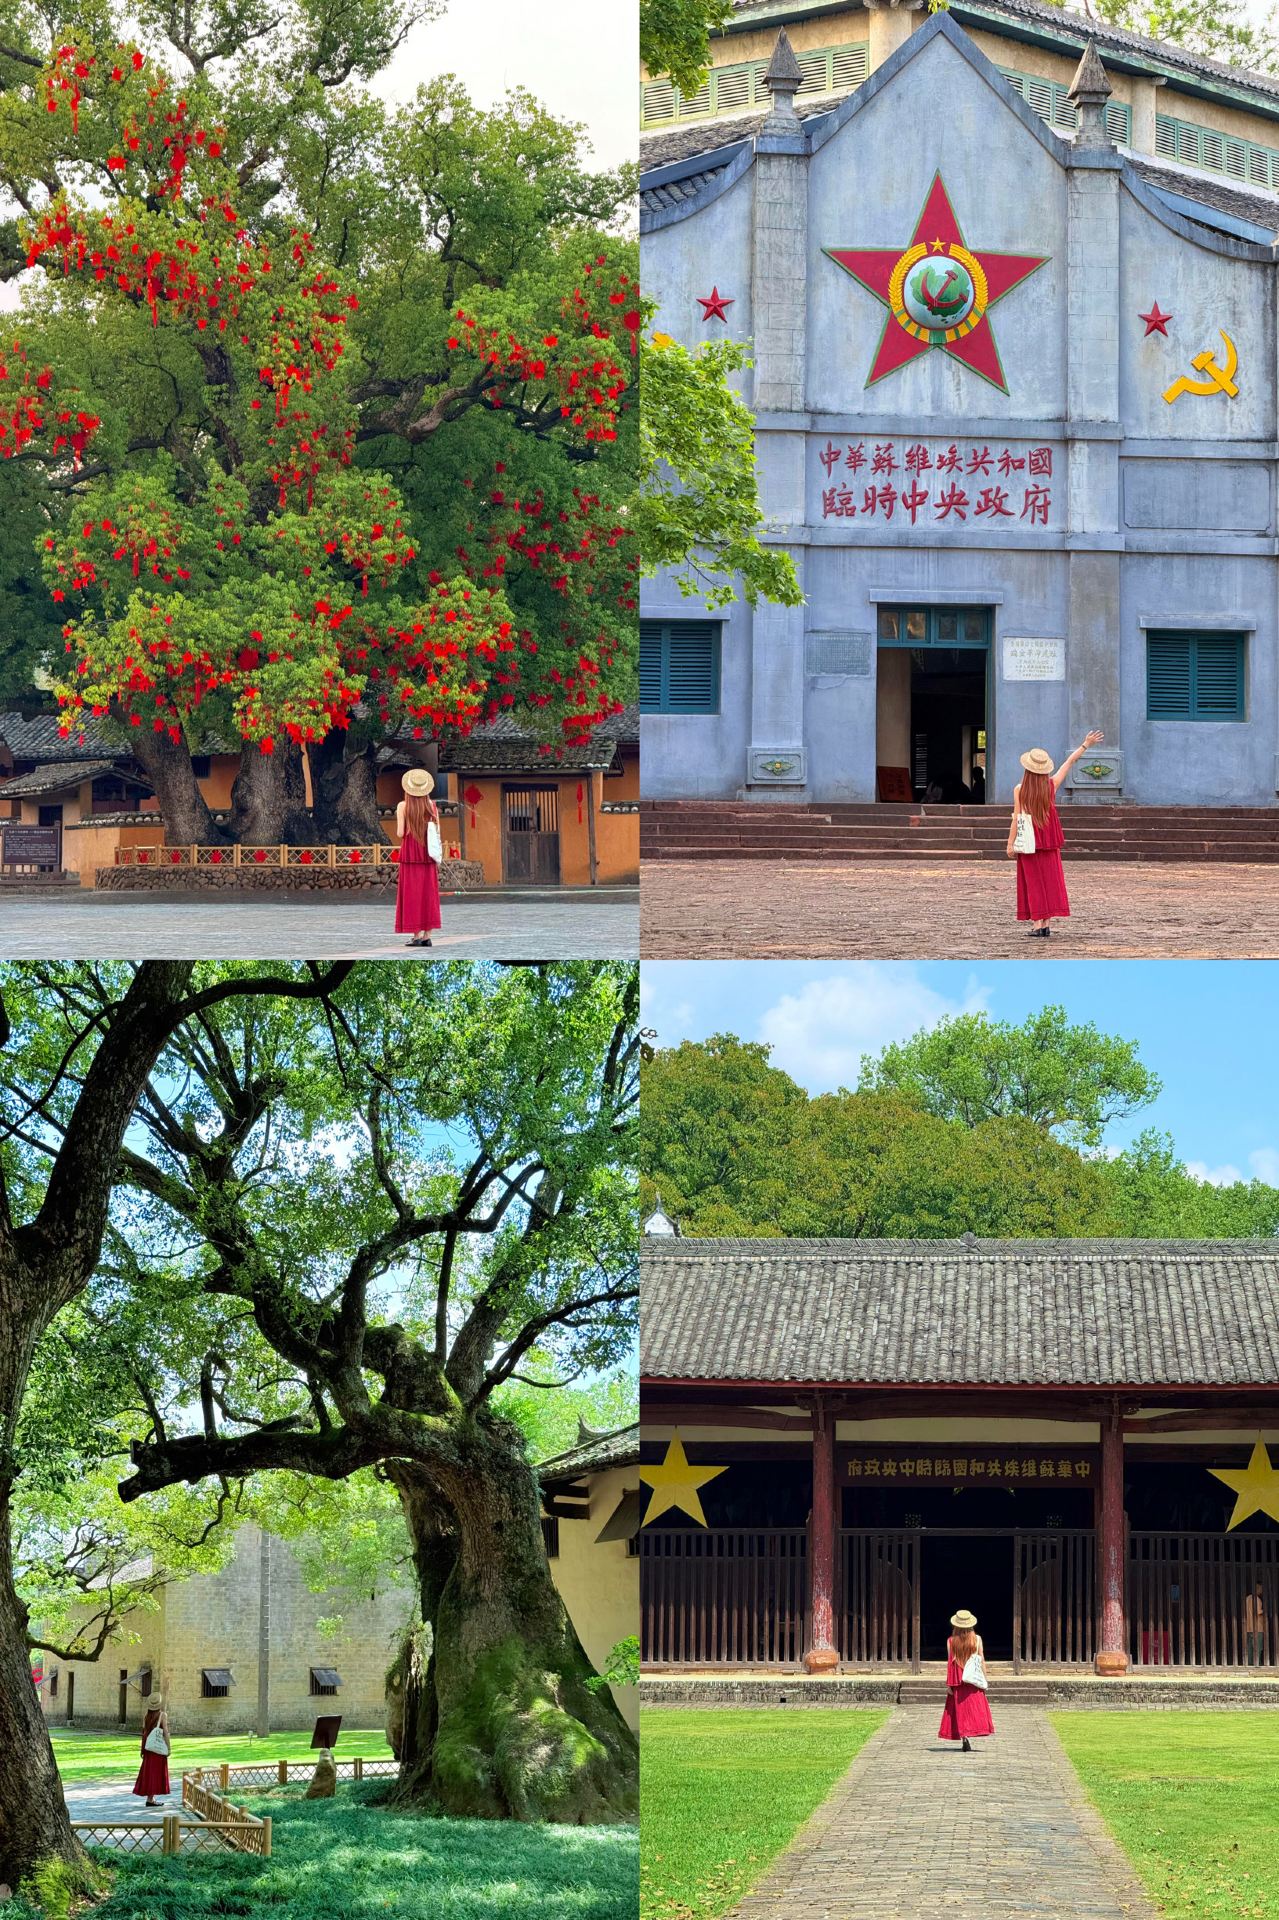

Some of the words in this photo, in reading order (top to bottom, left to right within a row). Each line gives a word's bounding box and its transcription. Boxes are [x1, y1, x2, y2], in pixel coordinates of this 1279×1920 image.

[819, 440, 1053, 478] 中華蘇維埃共和國
[822, 479, 1052, 526] 臨時中央政府
